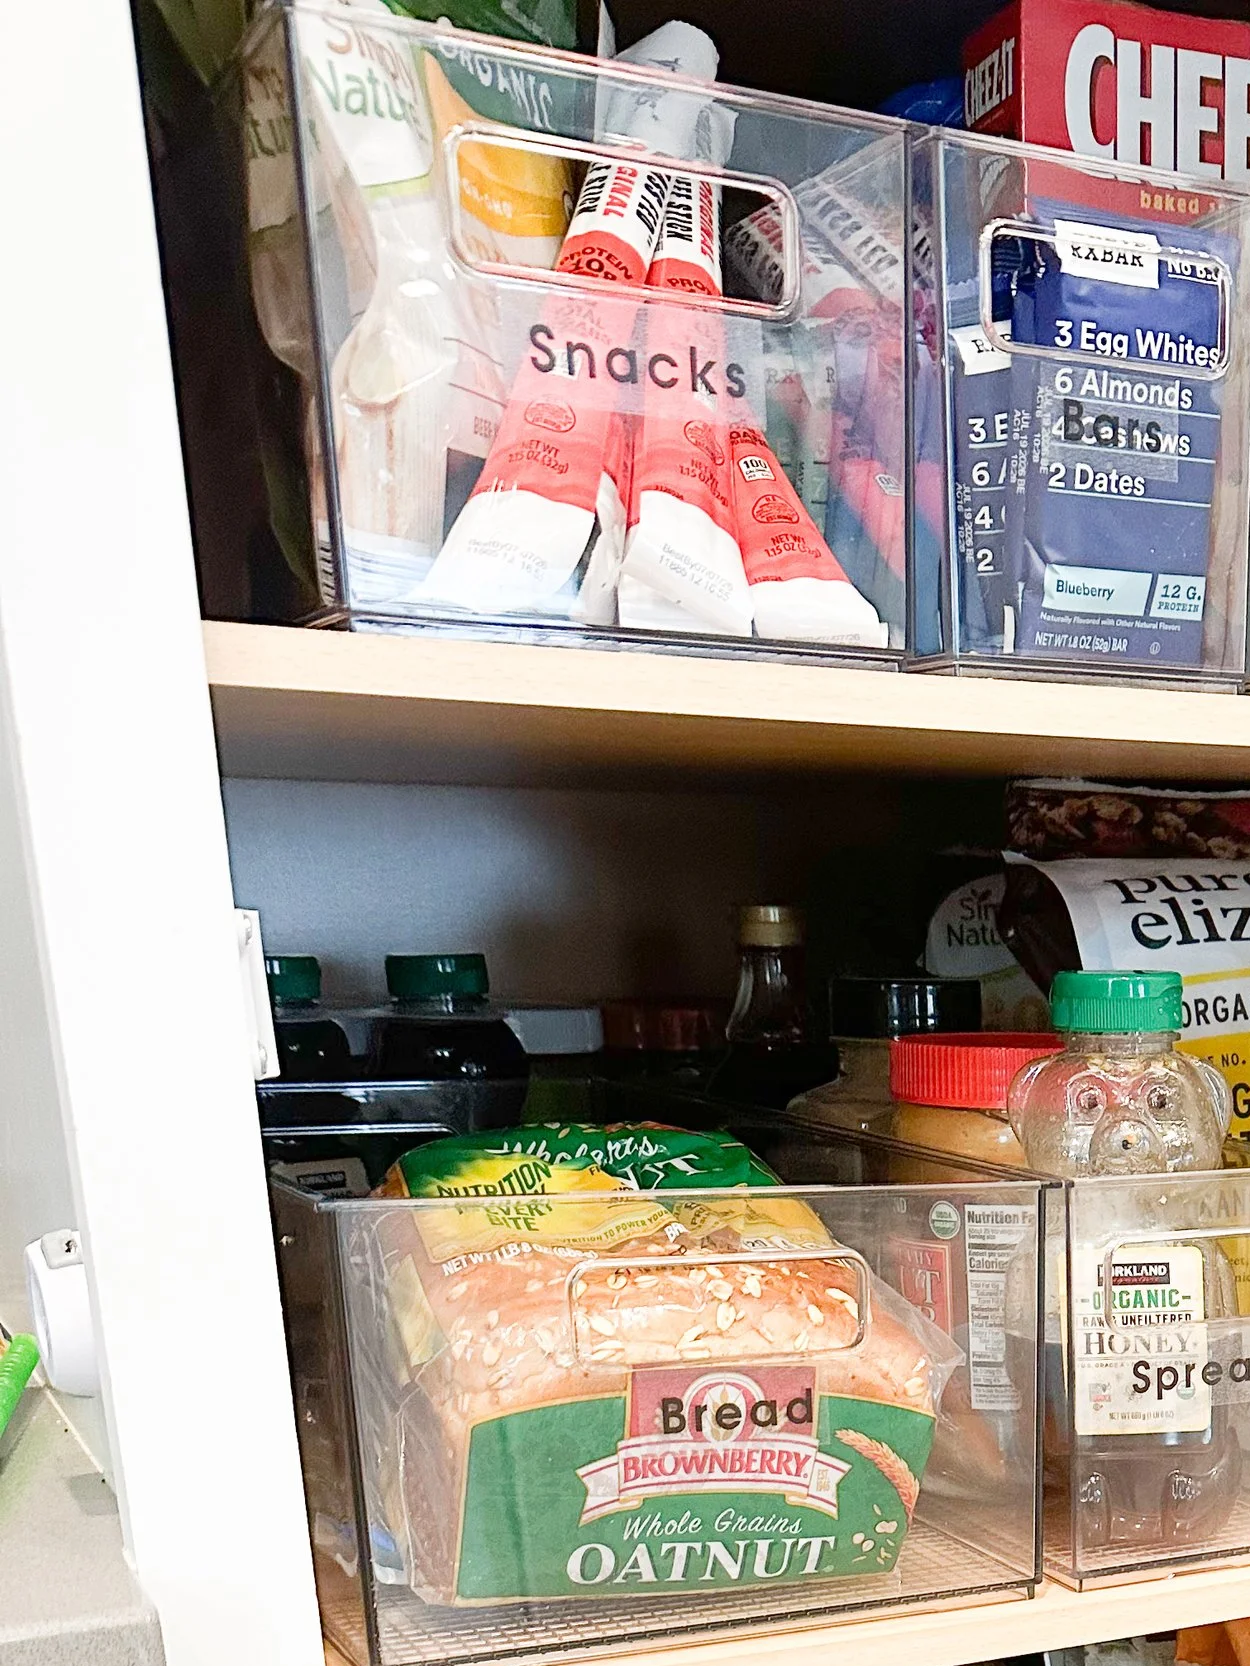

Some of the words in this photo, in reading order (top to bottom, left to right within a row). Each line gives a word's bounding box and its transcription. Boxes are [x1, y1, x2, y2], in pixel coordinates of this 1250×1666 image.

[1140, 190, 1199, 215] baked
[1054, 320, 1072, 347] 3
[1080, 322, 1129, 358] Egg
[1136, 328, 1220, 368] Whites
[531, 324, 746, 398] Snacks
[1054, 368, 1073, 394] 6
[1080, 374, 1193, 409] Almonds
[1062, 398, 1162, 453] Bars
[1050, 462, 1067, 489] 2
[1074, 464, 1146, 496] Dates
[1056, 579, 1115, 601] Blueberry
[1158, 601, 1199, 612] PROTEIN
[487, 1215, 540, 1232] BITE
[967, 1211, 1019, 1225] Nutrition
[1085, 1331, 1192, 1356] HONEY
[662, 1388, 813, 1434] Bread
[623, 1510, 703, 1541] Whole
[714, 1508, 803, 1534] Grains
[566, 1536, 836, 1585] OATNUT
